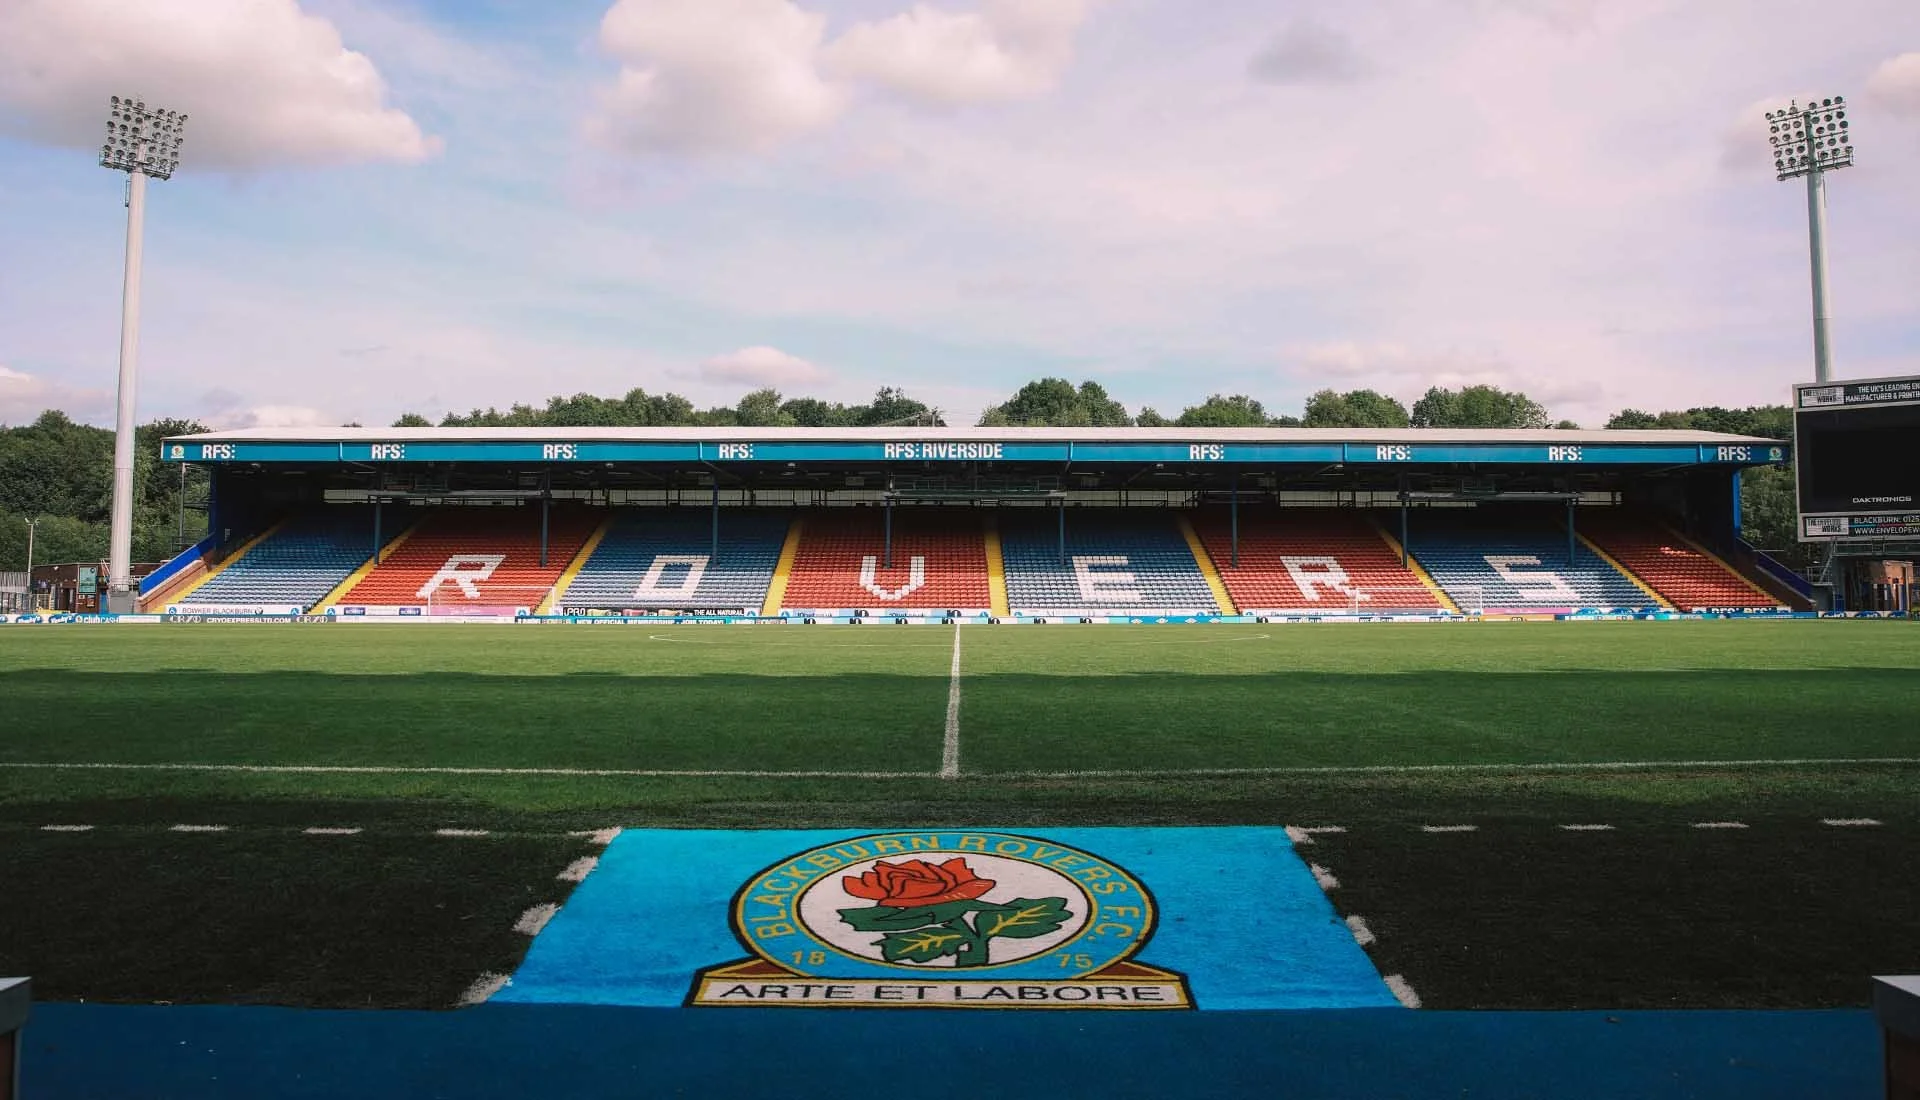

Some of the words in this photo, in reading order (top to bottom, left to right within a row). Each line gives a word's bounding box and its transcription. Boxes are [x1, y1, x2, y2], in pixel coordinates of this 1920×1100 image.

[1858, 386, 1870, 394] THE
[1884, 383, 1911, 392] LEADING
[1845, 392, 1892, 403] MANUFACTURER
[922, 443, 1003, 459] RIVERSIDE
[1852, 496, 1912, 504] DAKTRONICS
[756, 835, 949, 938] BLACKBURN
[960, 835, 1128, 896] ROVERS
[791, 949, 826, 967] 18
[1056, 952, 1093, 969] 75
[719, 984, 862, 1000] ARTE
[874, 984, 938, 1000] ET
[955, 984, 1166, 1001] LABORE
